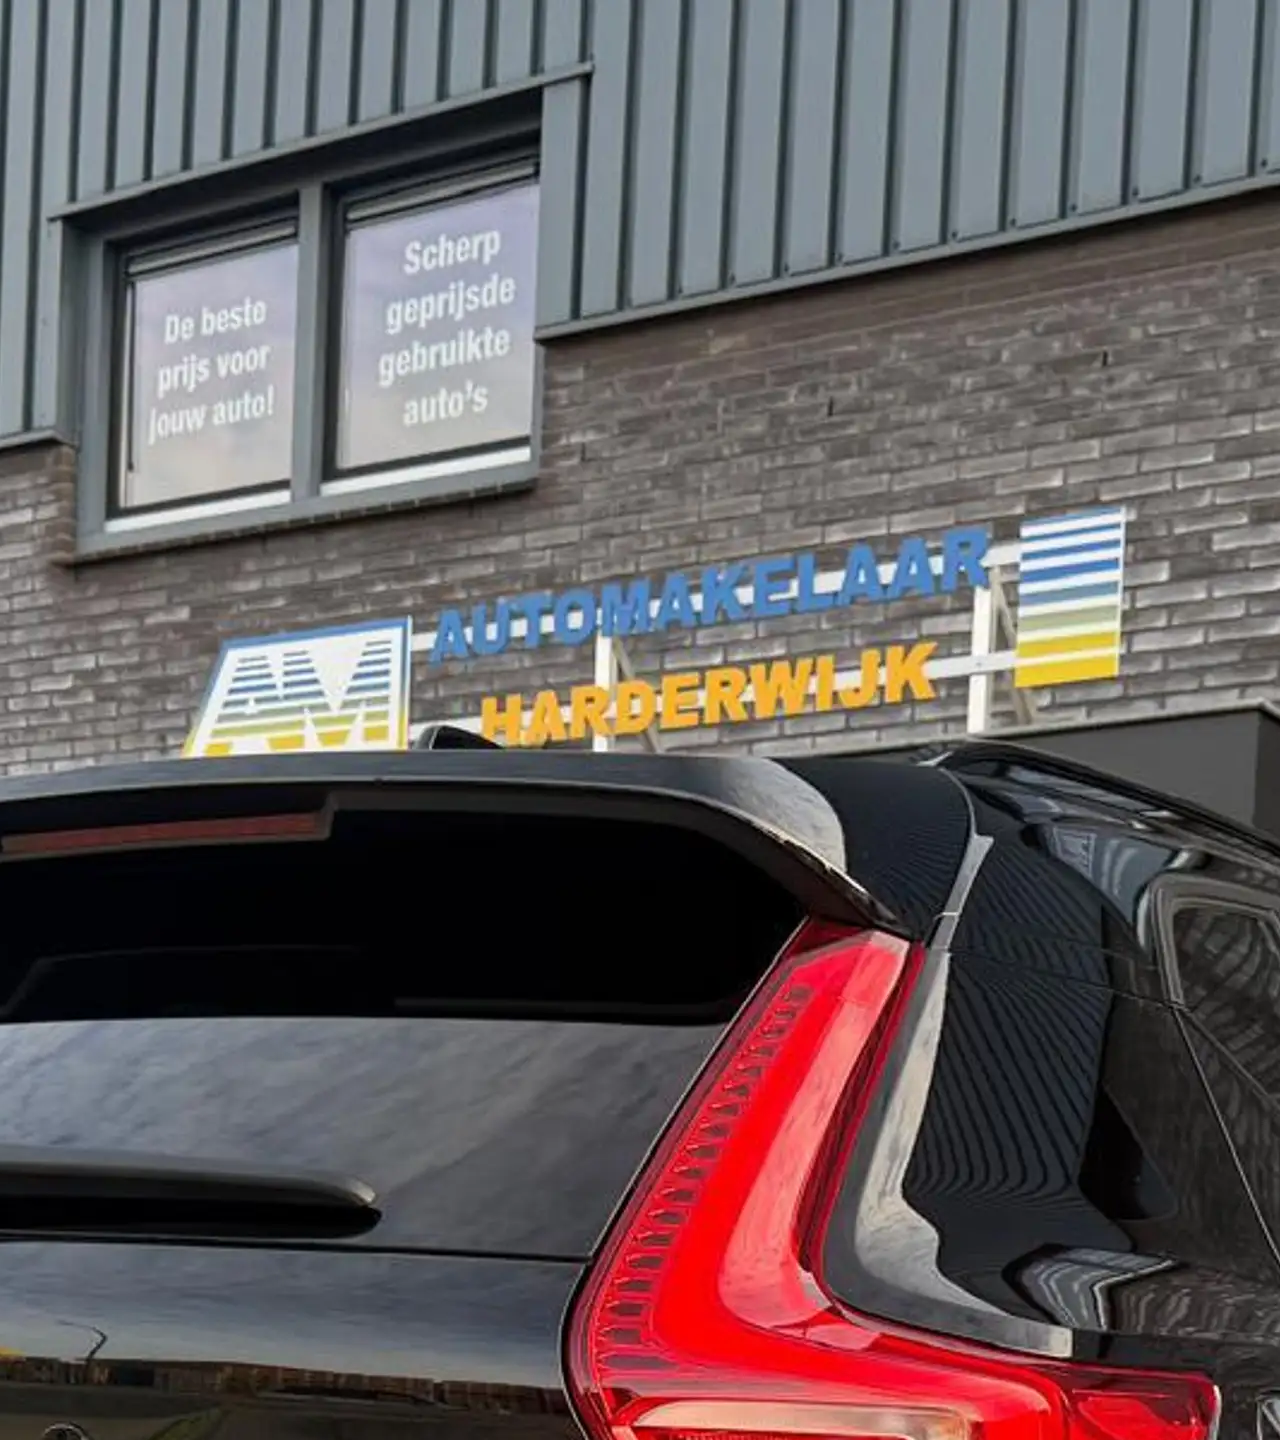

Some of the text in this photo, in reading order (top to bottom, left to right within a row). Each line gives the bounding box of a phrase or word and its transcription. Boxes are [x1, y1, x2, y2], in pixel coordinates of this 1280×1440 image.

[403, 230, 501, 275] Scherp
[164, 296, 268, 345] De beste
[385, 272, 516, 335] geprijsde
[157, 345, 271, 400] prijs voor
[378, 326, 511, 388] gebruikte
[148, 384, 275, 446] jouw auto!
[403, 378, 489, 427] auto's
[429, 525, 990, 665] AUTOMAKELAAR
[480, 641, 939, 748] HARDERWIJK
